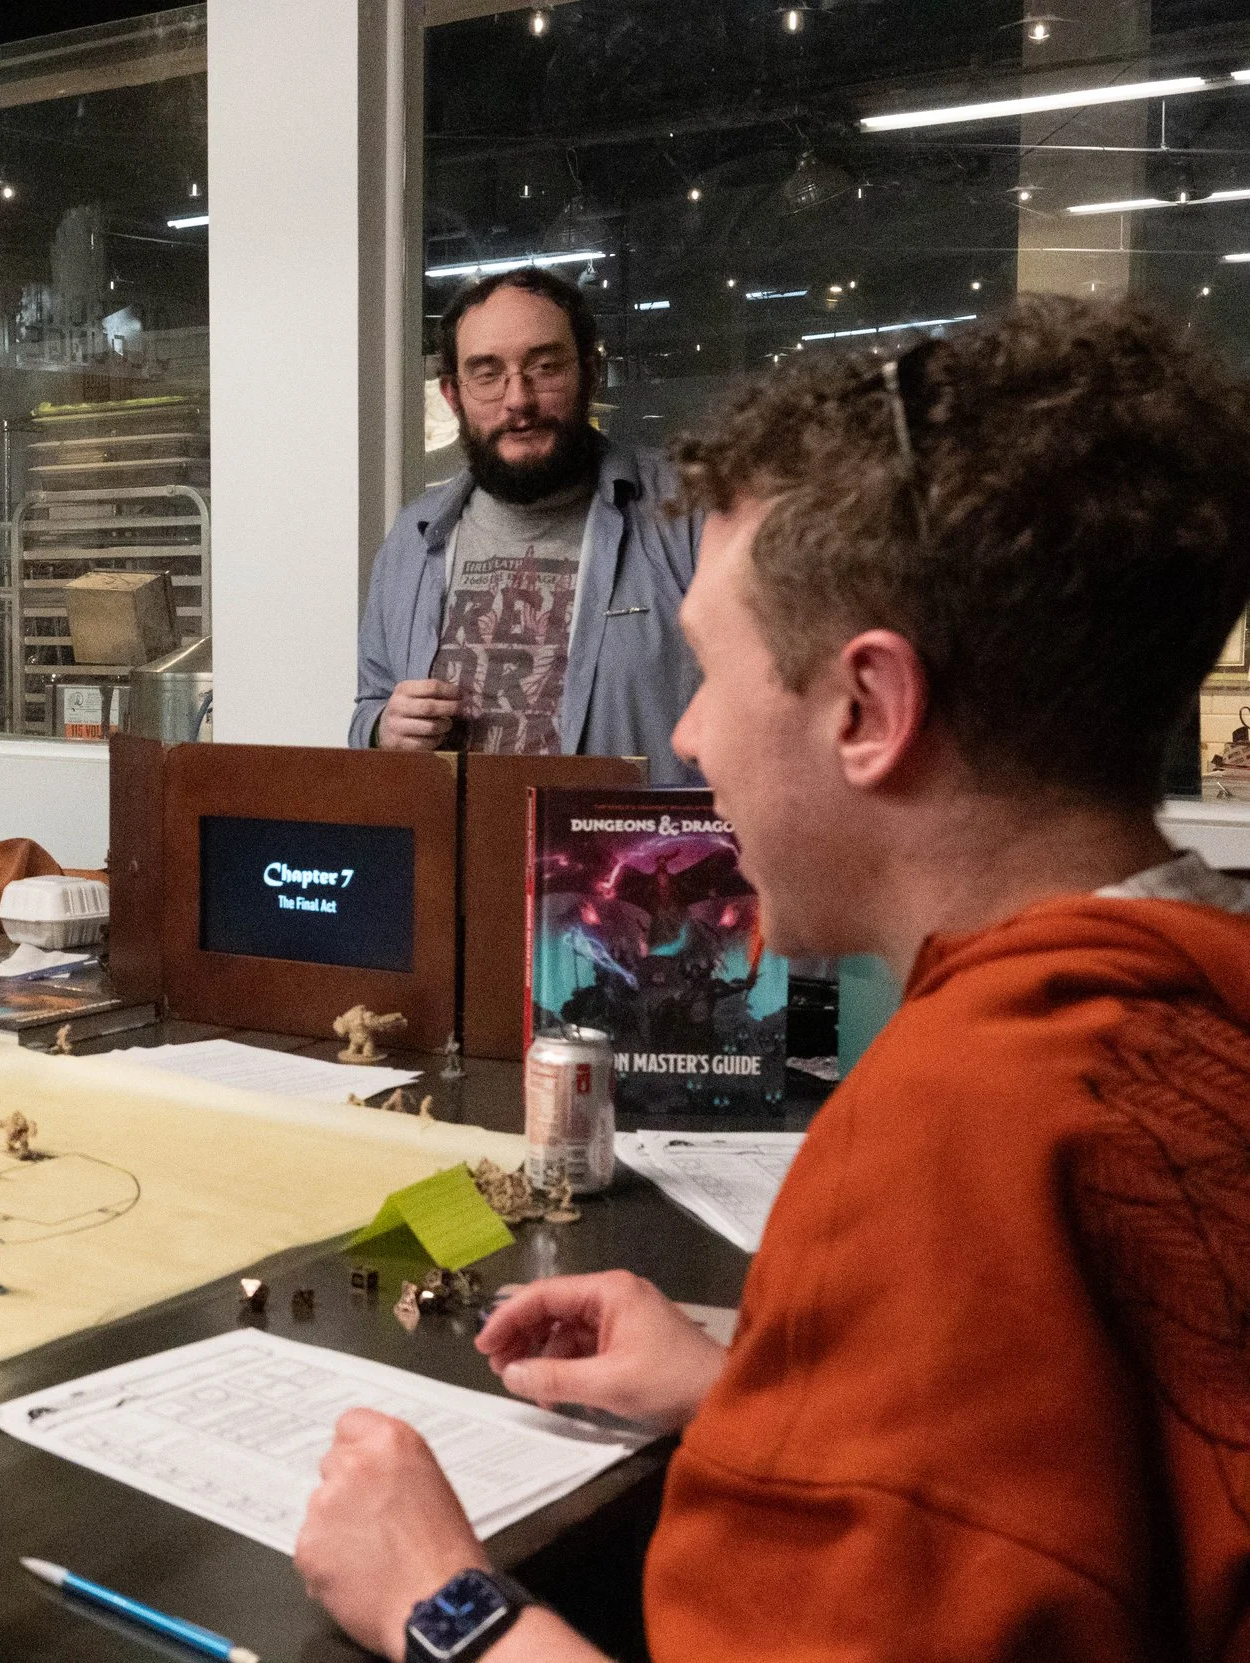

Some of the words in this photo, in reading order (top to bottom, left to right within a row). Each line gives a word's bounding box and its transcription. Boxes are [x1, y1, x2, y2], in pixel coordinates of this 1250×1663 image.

[71, 724, 83, 738] 115
[85, 724, 102, 738] VOL
[570, 818, 656, 832] DUNGEONS
[658, 815, 680, 836] &
[681, 820, 734, 833] DRAGO
[263, 861, 339, 889] Chapter
[340, 868, 355, 888] 7
[278, 894, 295, 910] The
[296, 896, 319, 912] Final
[320, 898, 337, 914] Act
[632, 1053, 710, 1074] MASTER'S
[712, 1055, 761, 1075] GUIDE
